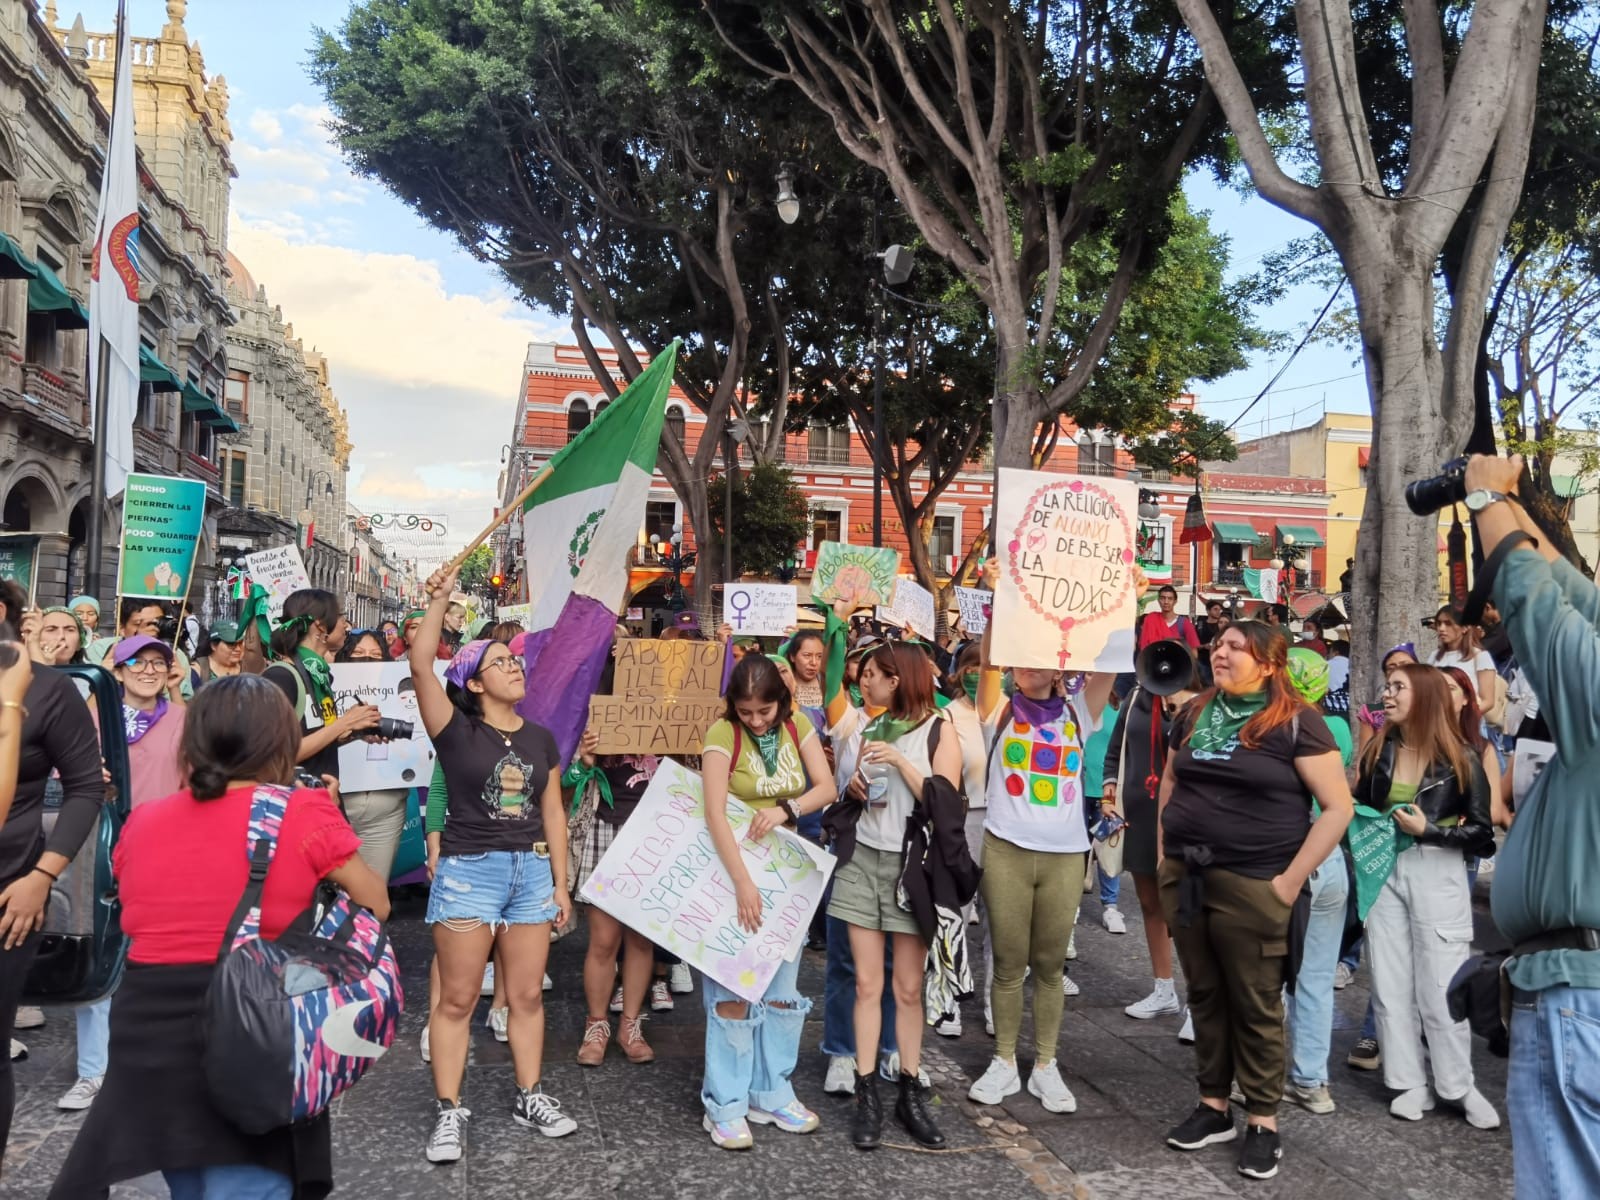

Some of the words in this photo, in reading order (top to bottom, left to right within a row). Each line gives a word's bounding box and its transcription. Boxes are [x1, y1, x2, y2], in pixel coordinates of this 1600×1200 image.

[130, 484, 167, 494] MUCHO
[1043, 493, 1060, 509] LA
[1033, 510, 1052, 528] DE
[125, 529, 154, 538] POCO
[280, 548, 289, 558] el
[1056, 537, 1102, 558] DEBE
[1104, 545, 1124, 566] SER
[278, 560, 286, 570] de
[818, 552, 864, 586] ABORTO
[1022, 551, 1044, 572] LA
[1101, 566, 1121, 588] DE
[617, 641, 719, 667] ABORTO
[625, 667, 716, 690] ILEGAL
[625, 688, 656, 704] ES
[598, 724, 709, 748] ESTATA
